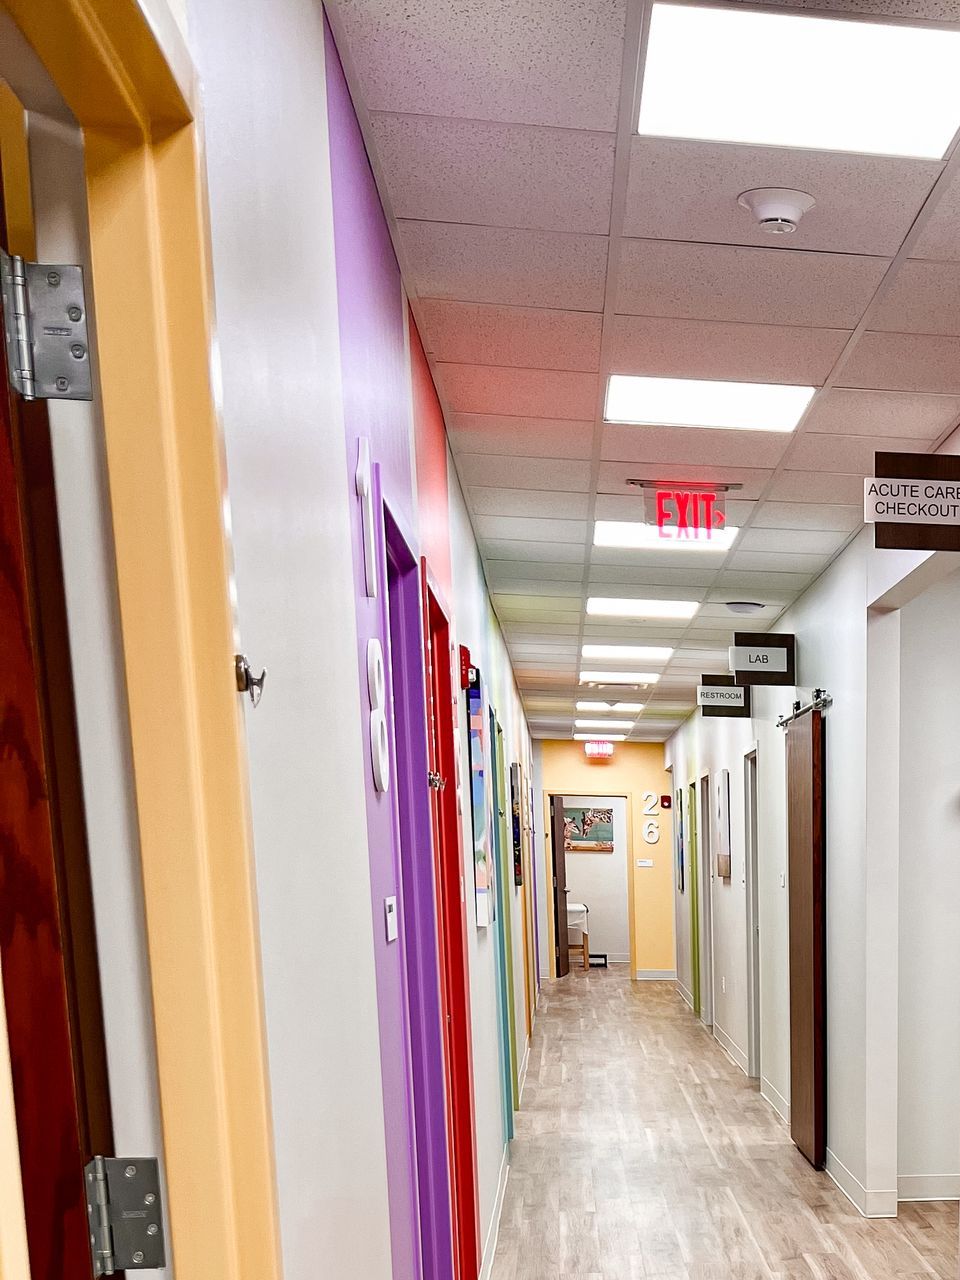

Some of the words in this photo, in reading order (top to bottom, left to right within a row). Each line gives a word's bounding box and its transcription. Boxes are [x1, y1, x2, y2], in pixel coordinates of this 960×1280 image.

[868, 483, 920, 498] ACUTE
[655, 490, 717, 540] EXIT
[874, 501, 960, 518] CHECKOUT
[748, 654, 769, 664] LAB
[700, 691, 742, 700] RESTROOM
